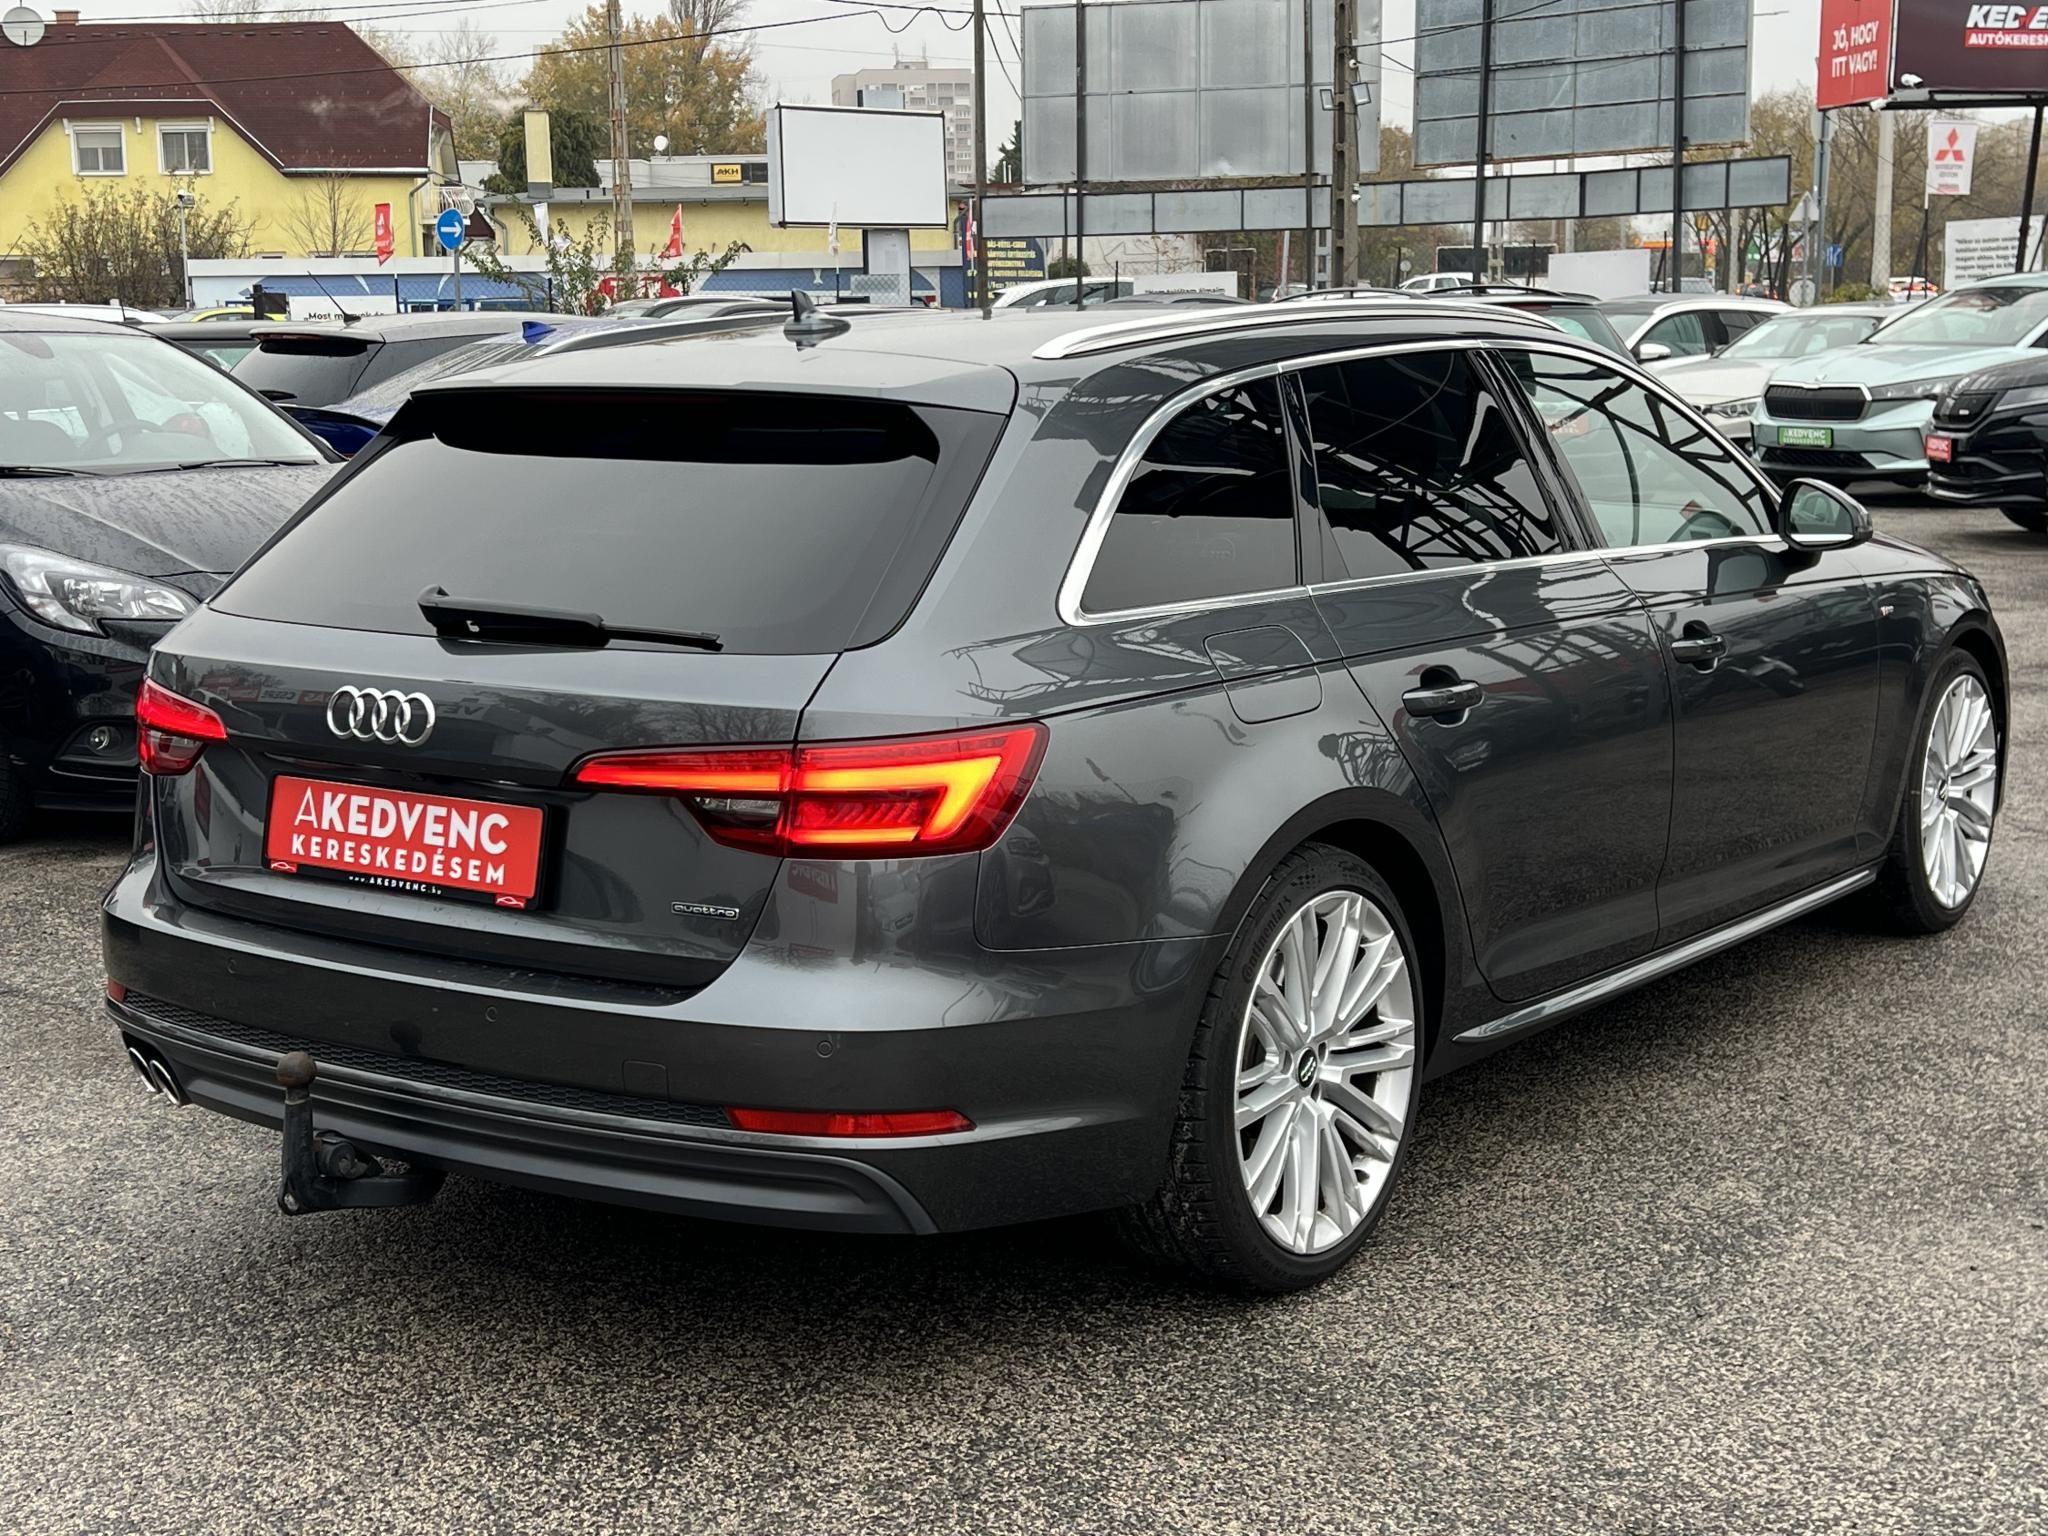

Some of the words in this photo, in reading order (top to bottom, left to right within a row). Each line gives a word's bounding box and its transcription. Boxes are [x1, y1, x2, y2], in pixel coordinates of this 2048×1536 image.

[1966, 5, 2048, 29] KEDVE
[1833, 23, 1849, 52] JÓ,
[1850, 20, 1879, 47] HOGY
[1832, 55, 1848, 78] ITT
[1849, 49, 1878, 75] VAGY!
[295, 785, 510, 855] AKEDVENC
[291, 833, 505, 886] KERESKEDÉSEM
[674, 904, 736, 918] quattro
